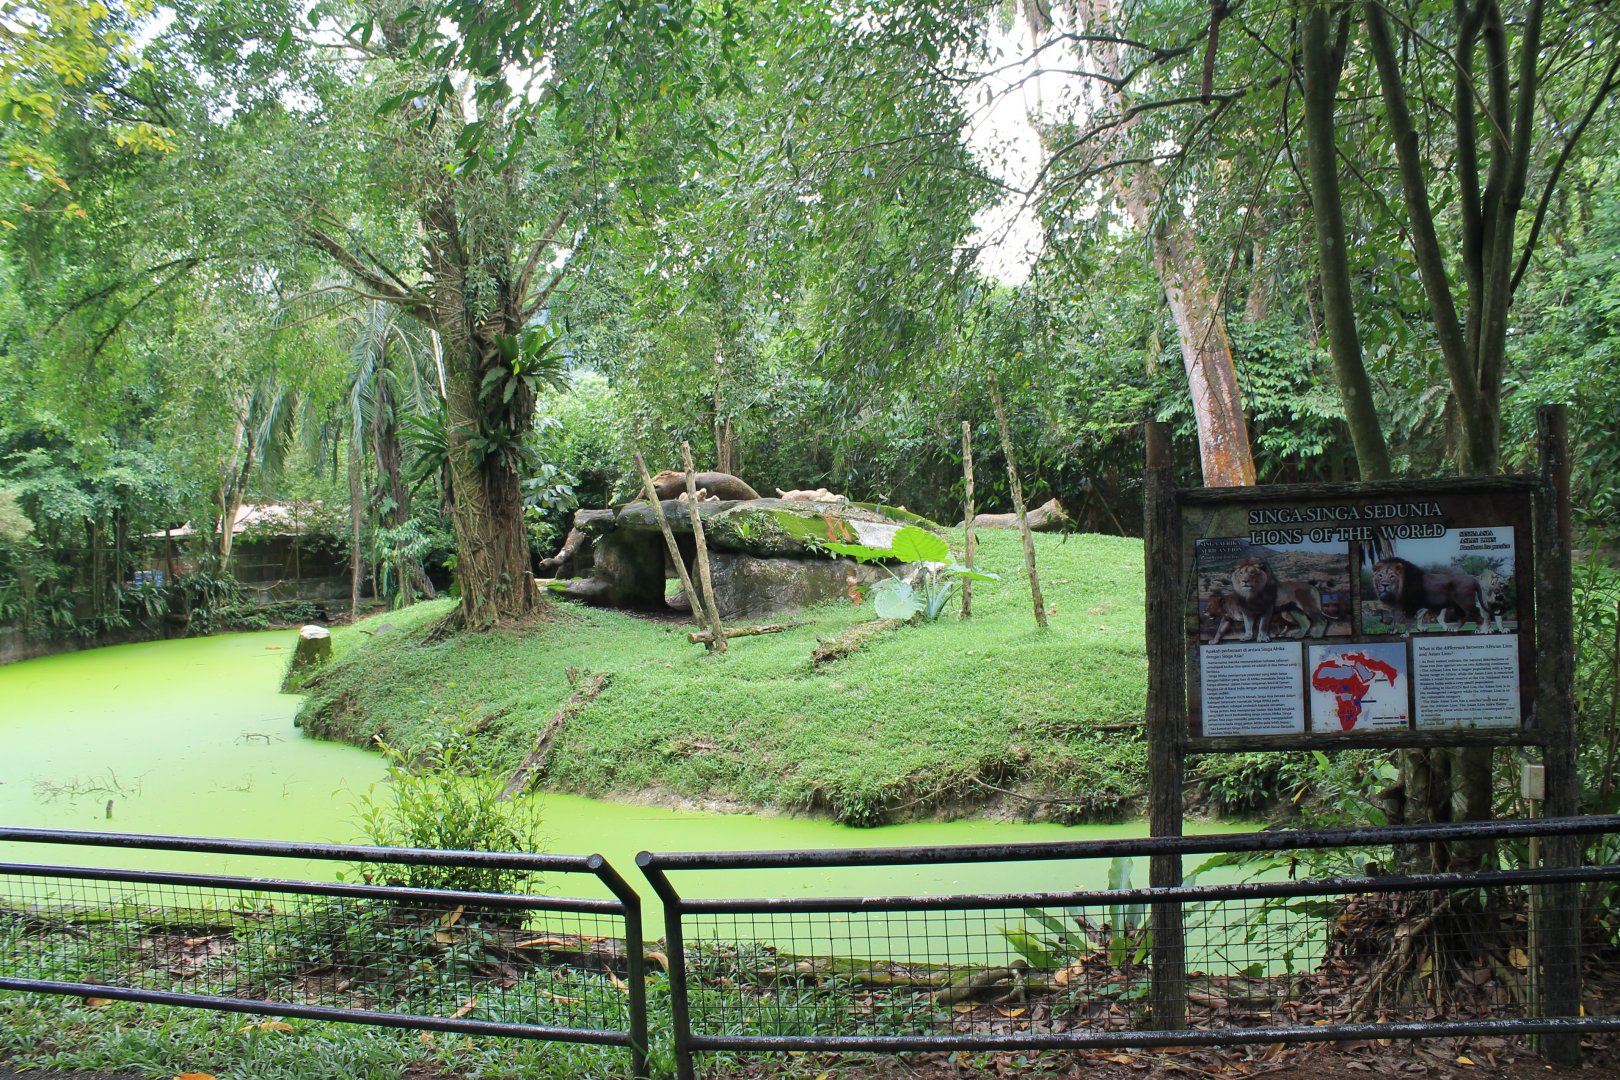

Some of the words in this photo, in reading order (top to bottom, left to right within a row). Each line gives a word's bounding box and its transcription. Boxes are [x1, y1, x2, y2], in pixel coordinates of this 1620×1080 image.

[1249, 506, 1360, 524] SINGA-SINGA
[1364, 502, 1443, 519] SEDUNIA
[1250, 529, 1303, 545] LIONS
[1309, 528, 1333, 543] OF
[1337, 526, 1373, 541] THE
[1381, 523, 1445, 539] WORLD
